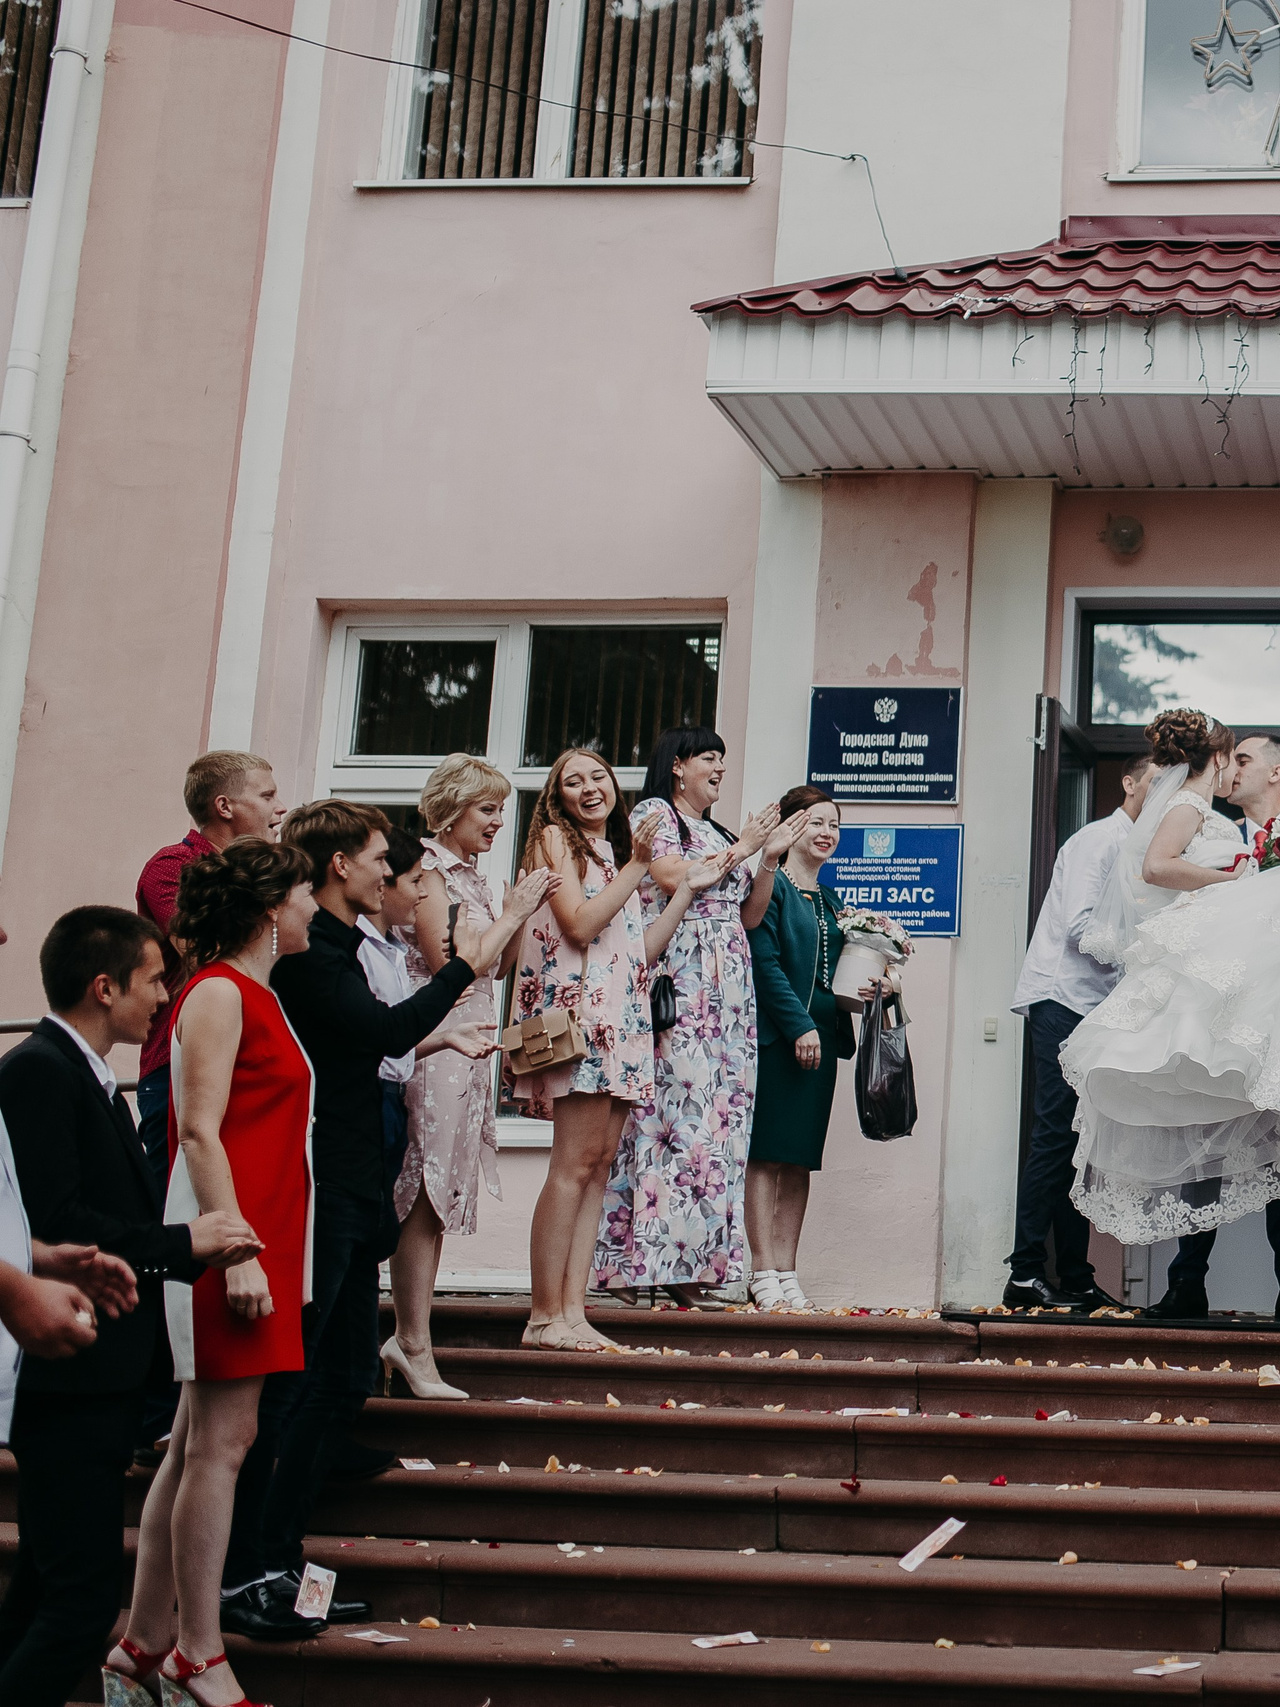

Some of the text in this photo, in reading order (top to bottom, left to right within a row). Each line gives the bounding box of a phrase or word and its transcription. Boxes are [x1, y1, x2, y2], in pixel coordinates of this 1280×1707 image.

[840, 732, 929, 748] Городская Дума
[842, 751, 924, 767] города Сергача
[811, 772, 953, 783] Сергачского муниципального района
[833, 783, 929, 793] Нижегородской области
[850, 857, 892, 866] управление
[892, 857, 917, 865] записи
[918, 857, 938, 865] актов
[836, 872, 920, 882] Нижегородской области
[834, 887, 935, 905] ТДЕЛ ЗАГС
[921, 909, 950, 919] района
[895, 918, 924, 926] бласти
